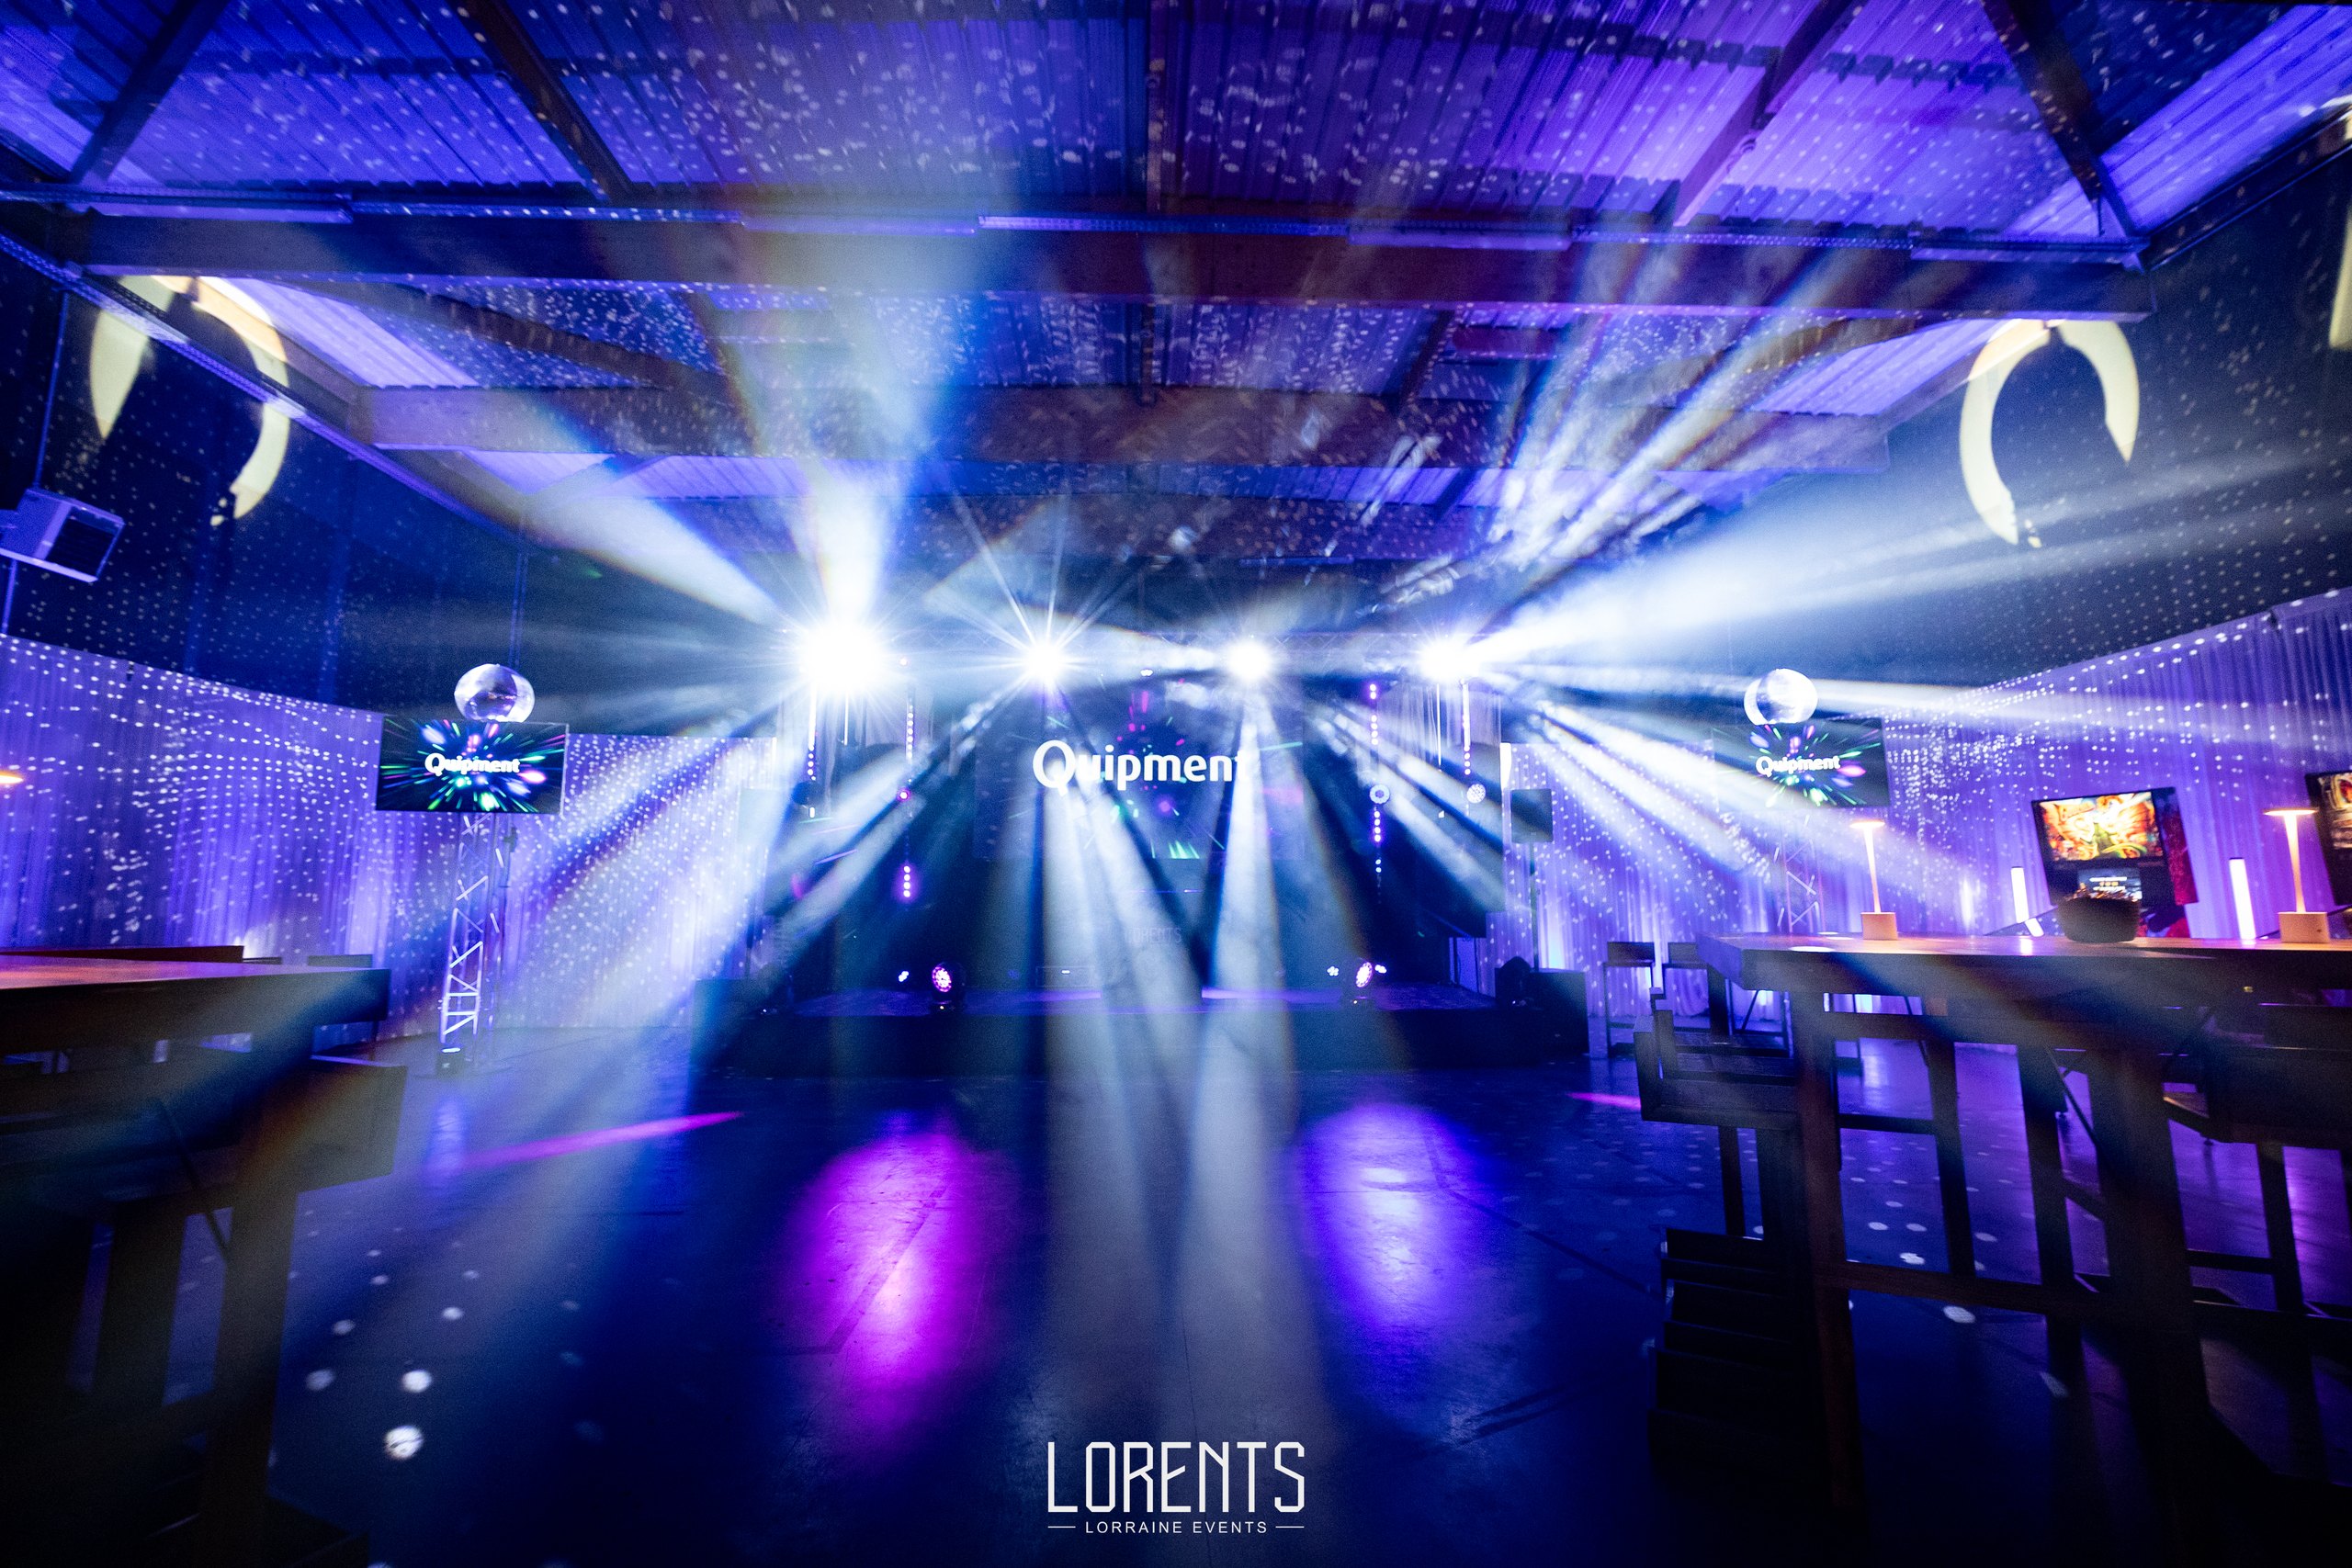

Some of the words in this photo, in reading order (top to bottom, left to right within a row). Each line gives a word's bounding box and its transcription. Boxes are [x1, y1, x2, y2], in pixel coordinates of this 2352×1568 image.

[424, 752, 520, 776] Quipment
[1033, 739, 1250, 796] Quipment
[1755, 756, 1840, 777] Quipment
